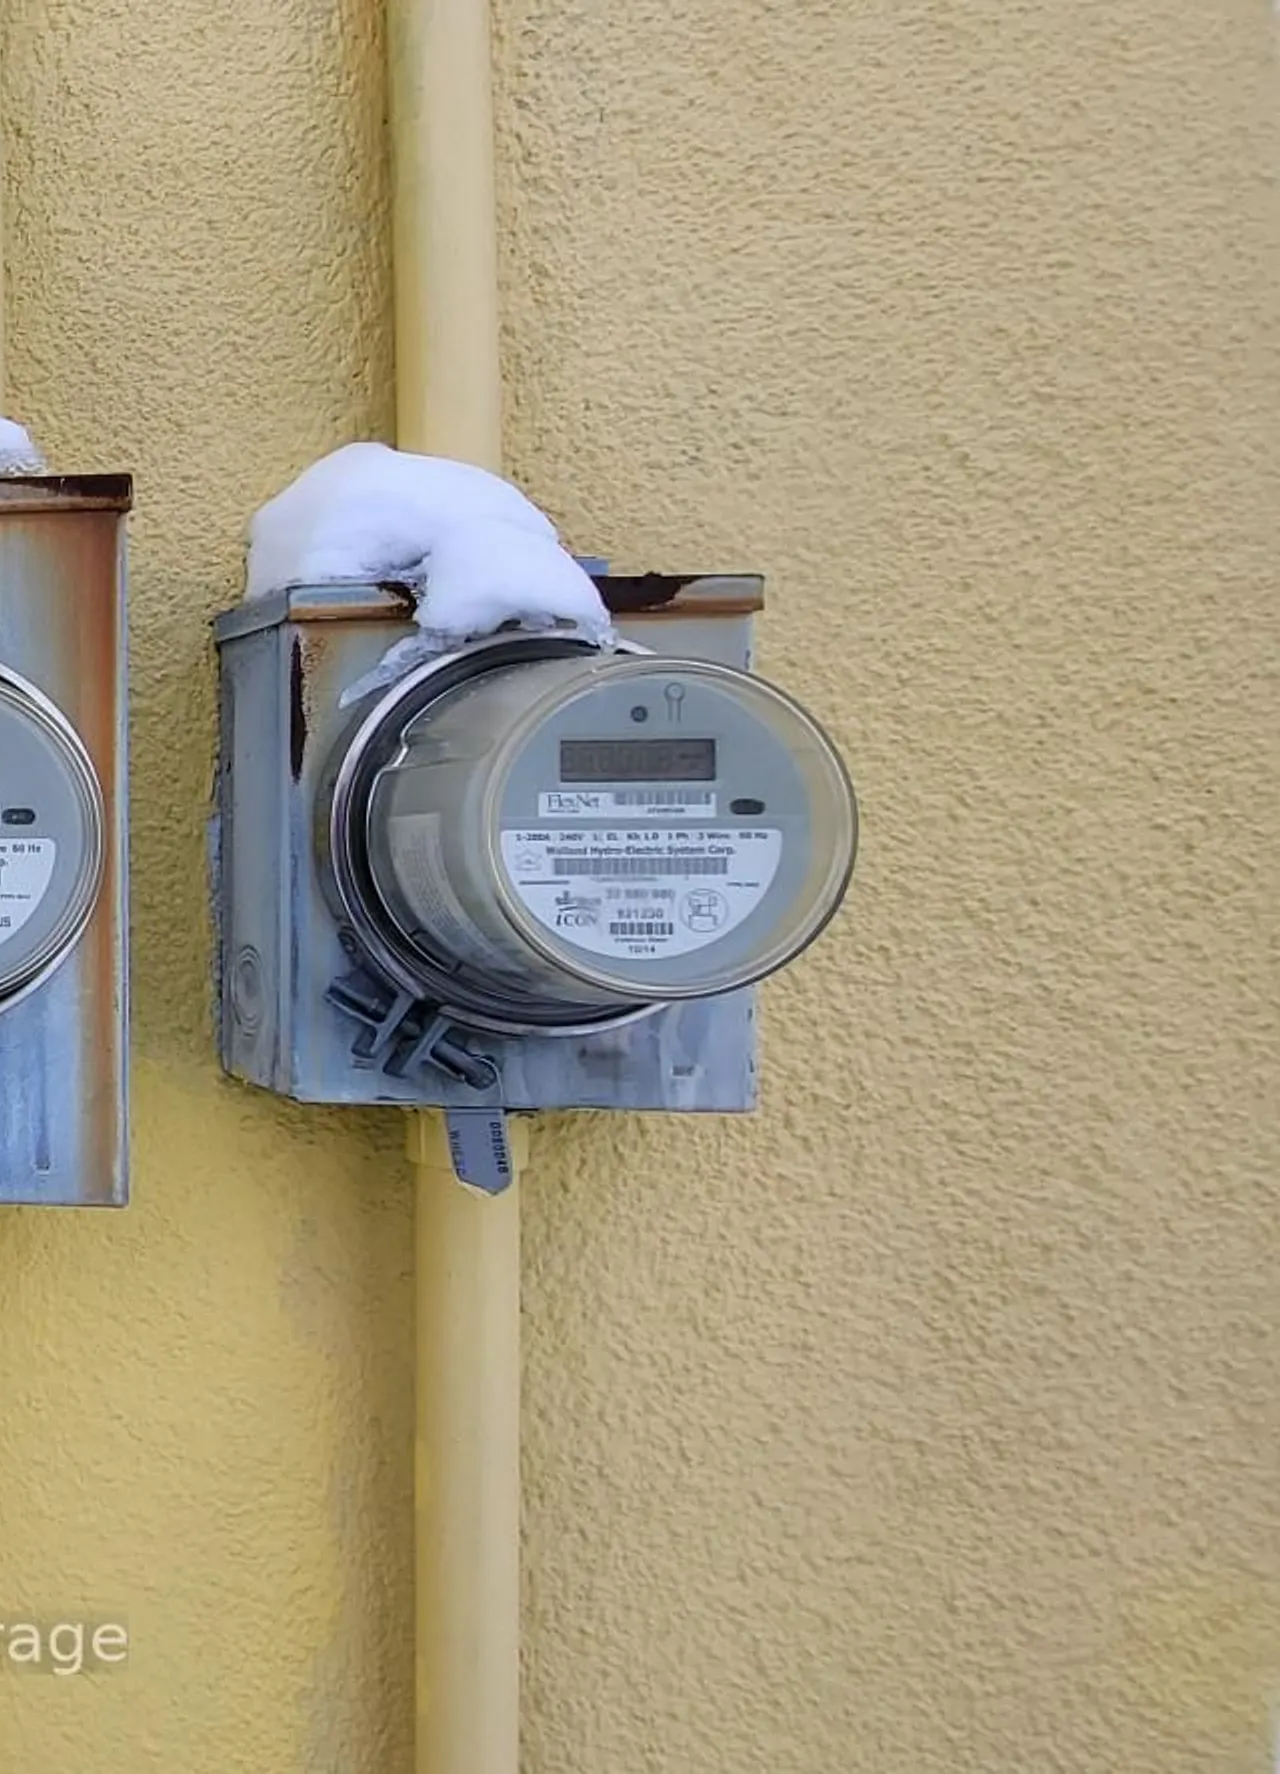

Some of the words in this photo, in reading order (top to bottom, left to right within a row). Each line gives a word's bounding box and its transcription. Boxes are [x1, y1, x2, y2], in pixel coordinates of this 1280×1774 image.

[547, 794, 599, 808] FlexNet
[590, 846, 663, 857] Hydro-Electric
[667, 846, 704, 857] System
